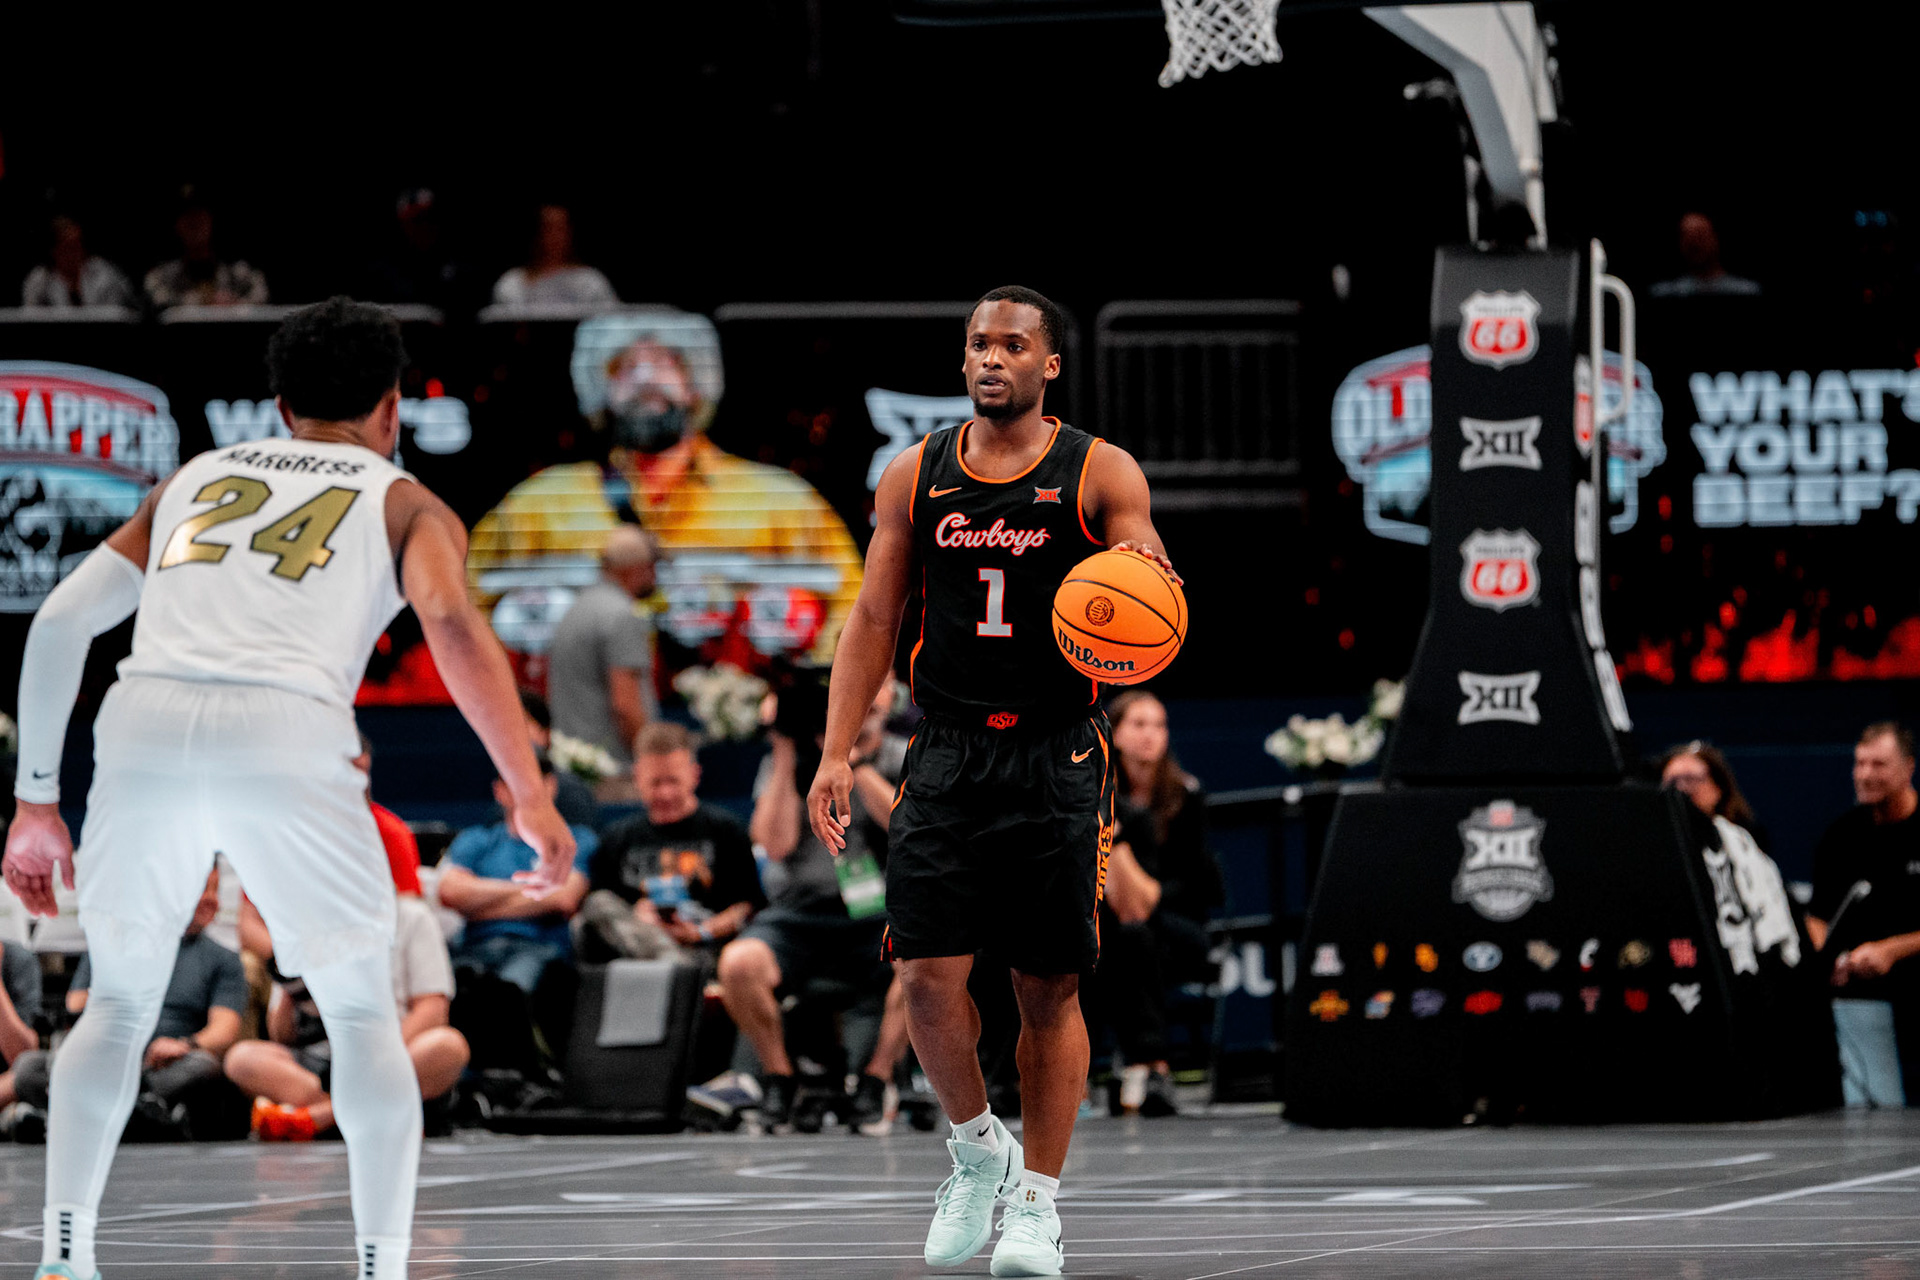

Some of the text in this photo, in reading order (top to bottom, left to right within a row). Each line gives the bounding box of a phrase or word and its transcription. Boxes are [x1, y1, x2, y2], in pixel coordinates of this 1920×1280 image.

[1476, 319, 1521, 350] 66
[1690, 422, 1888, 474] YOUR
[158, 475, 361, 582] 24
[935, 512, 1051, 556] Cowboys
[1477, 560, 1523, 592] 66
[976, 567, 1013, 637] 1
[1058, 626, 1135, 671] Wilson
[986, 711, 1019, 730] OSU
